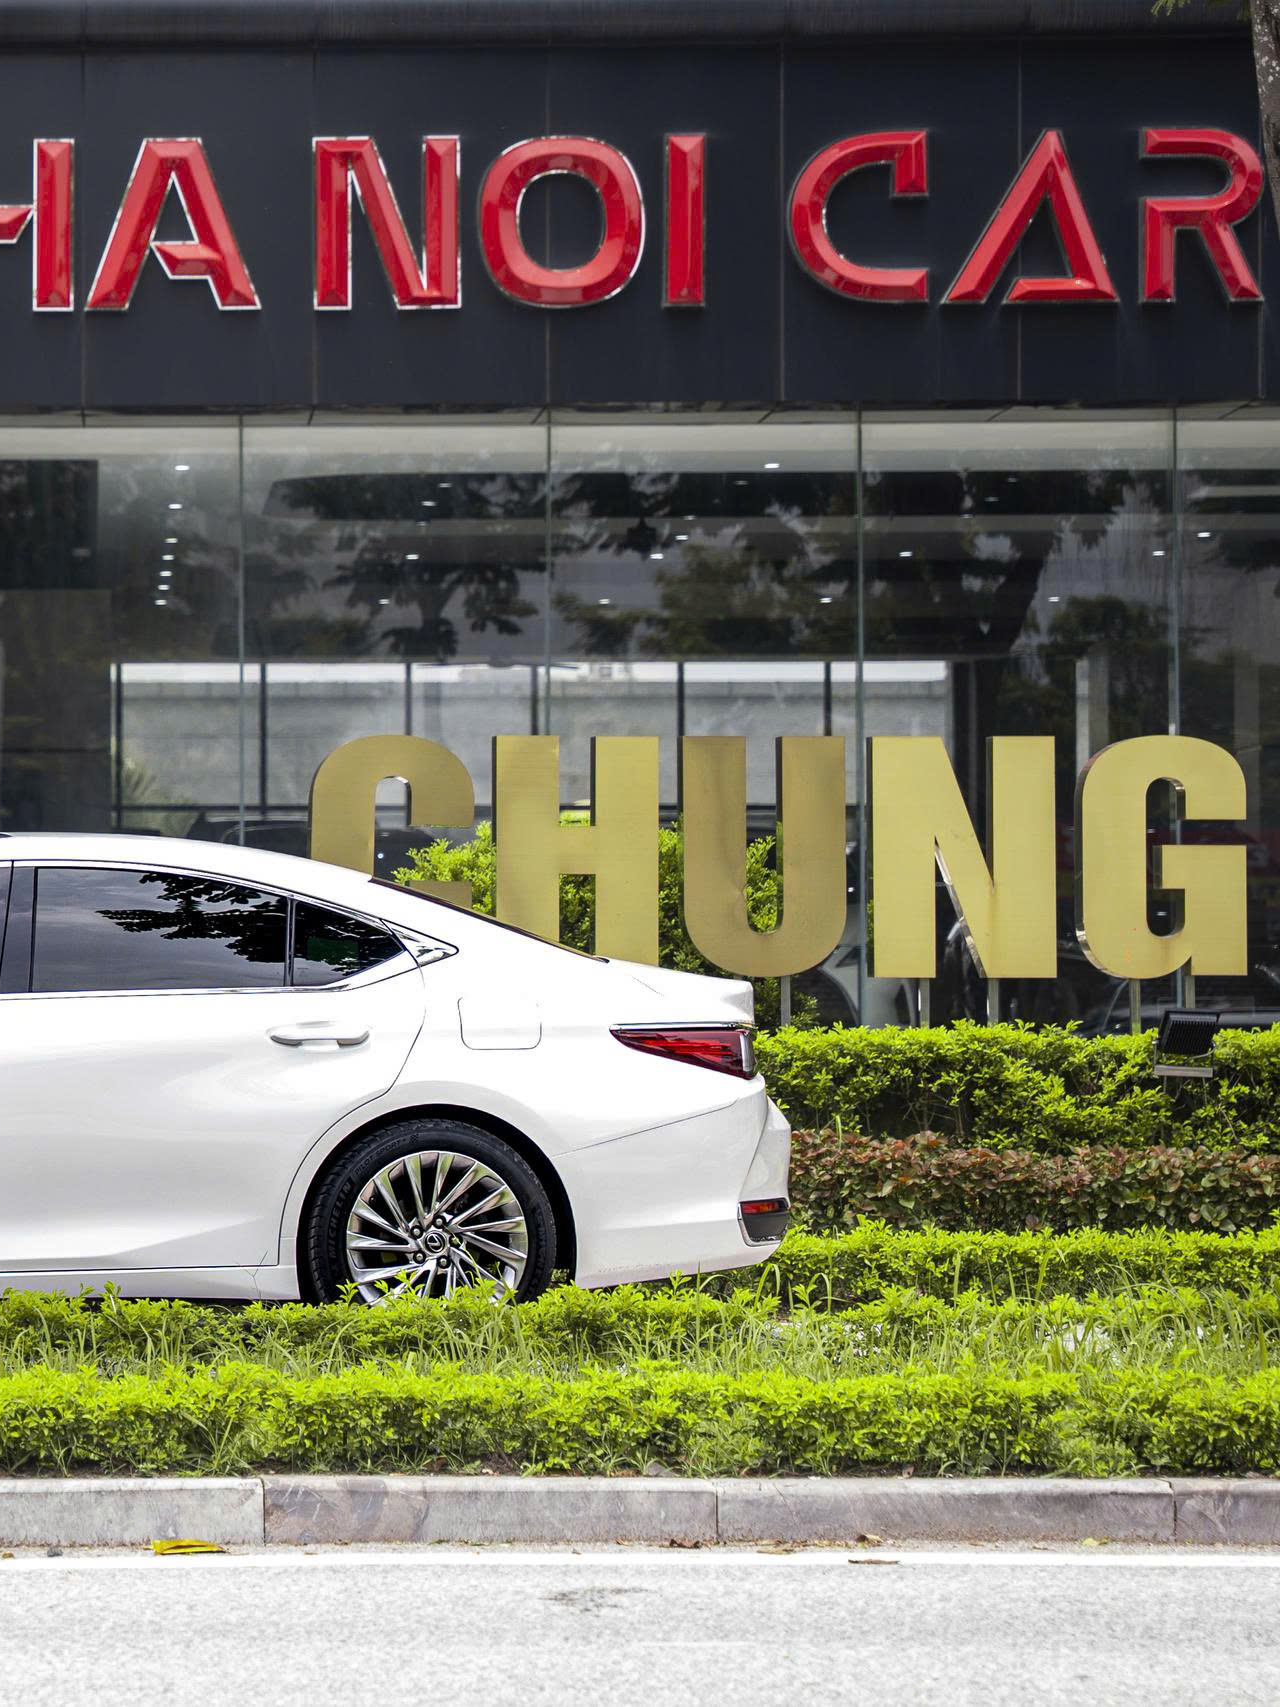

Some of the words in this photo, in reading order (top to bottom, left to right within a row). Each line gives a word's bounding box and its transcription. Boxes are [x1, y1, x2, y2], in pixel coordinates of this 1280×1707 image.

[312, 134, 707, 312] NOI
[788, 127, 1265, 304] CAR
[307, 734, 1248, 979] CHUNG
[328, 1180, 353, 1259] MICHELIN
